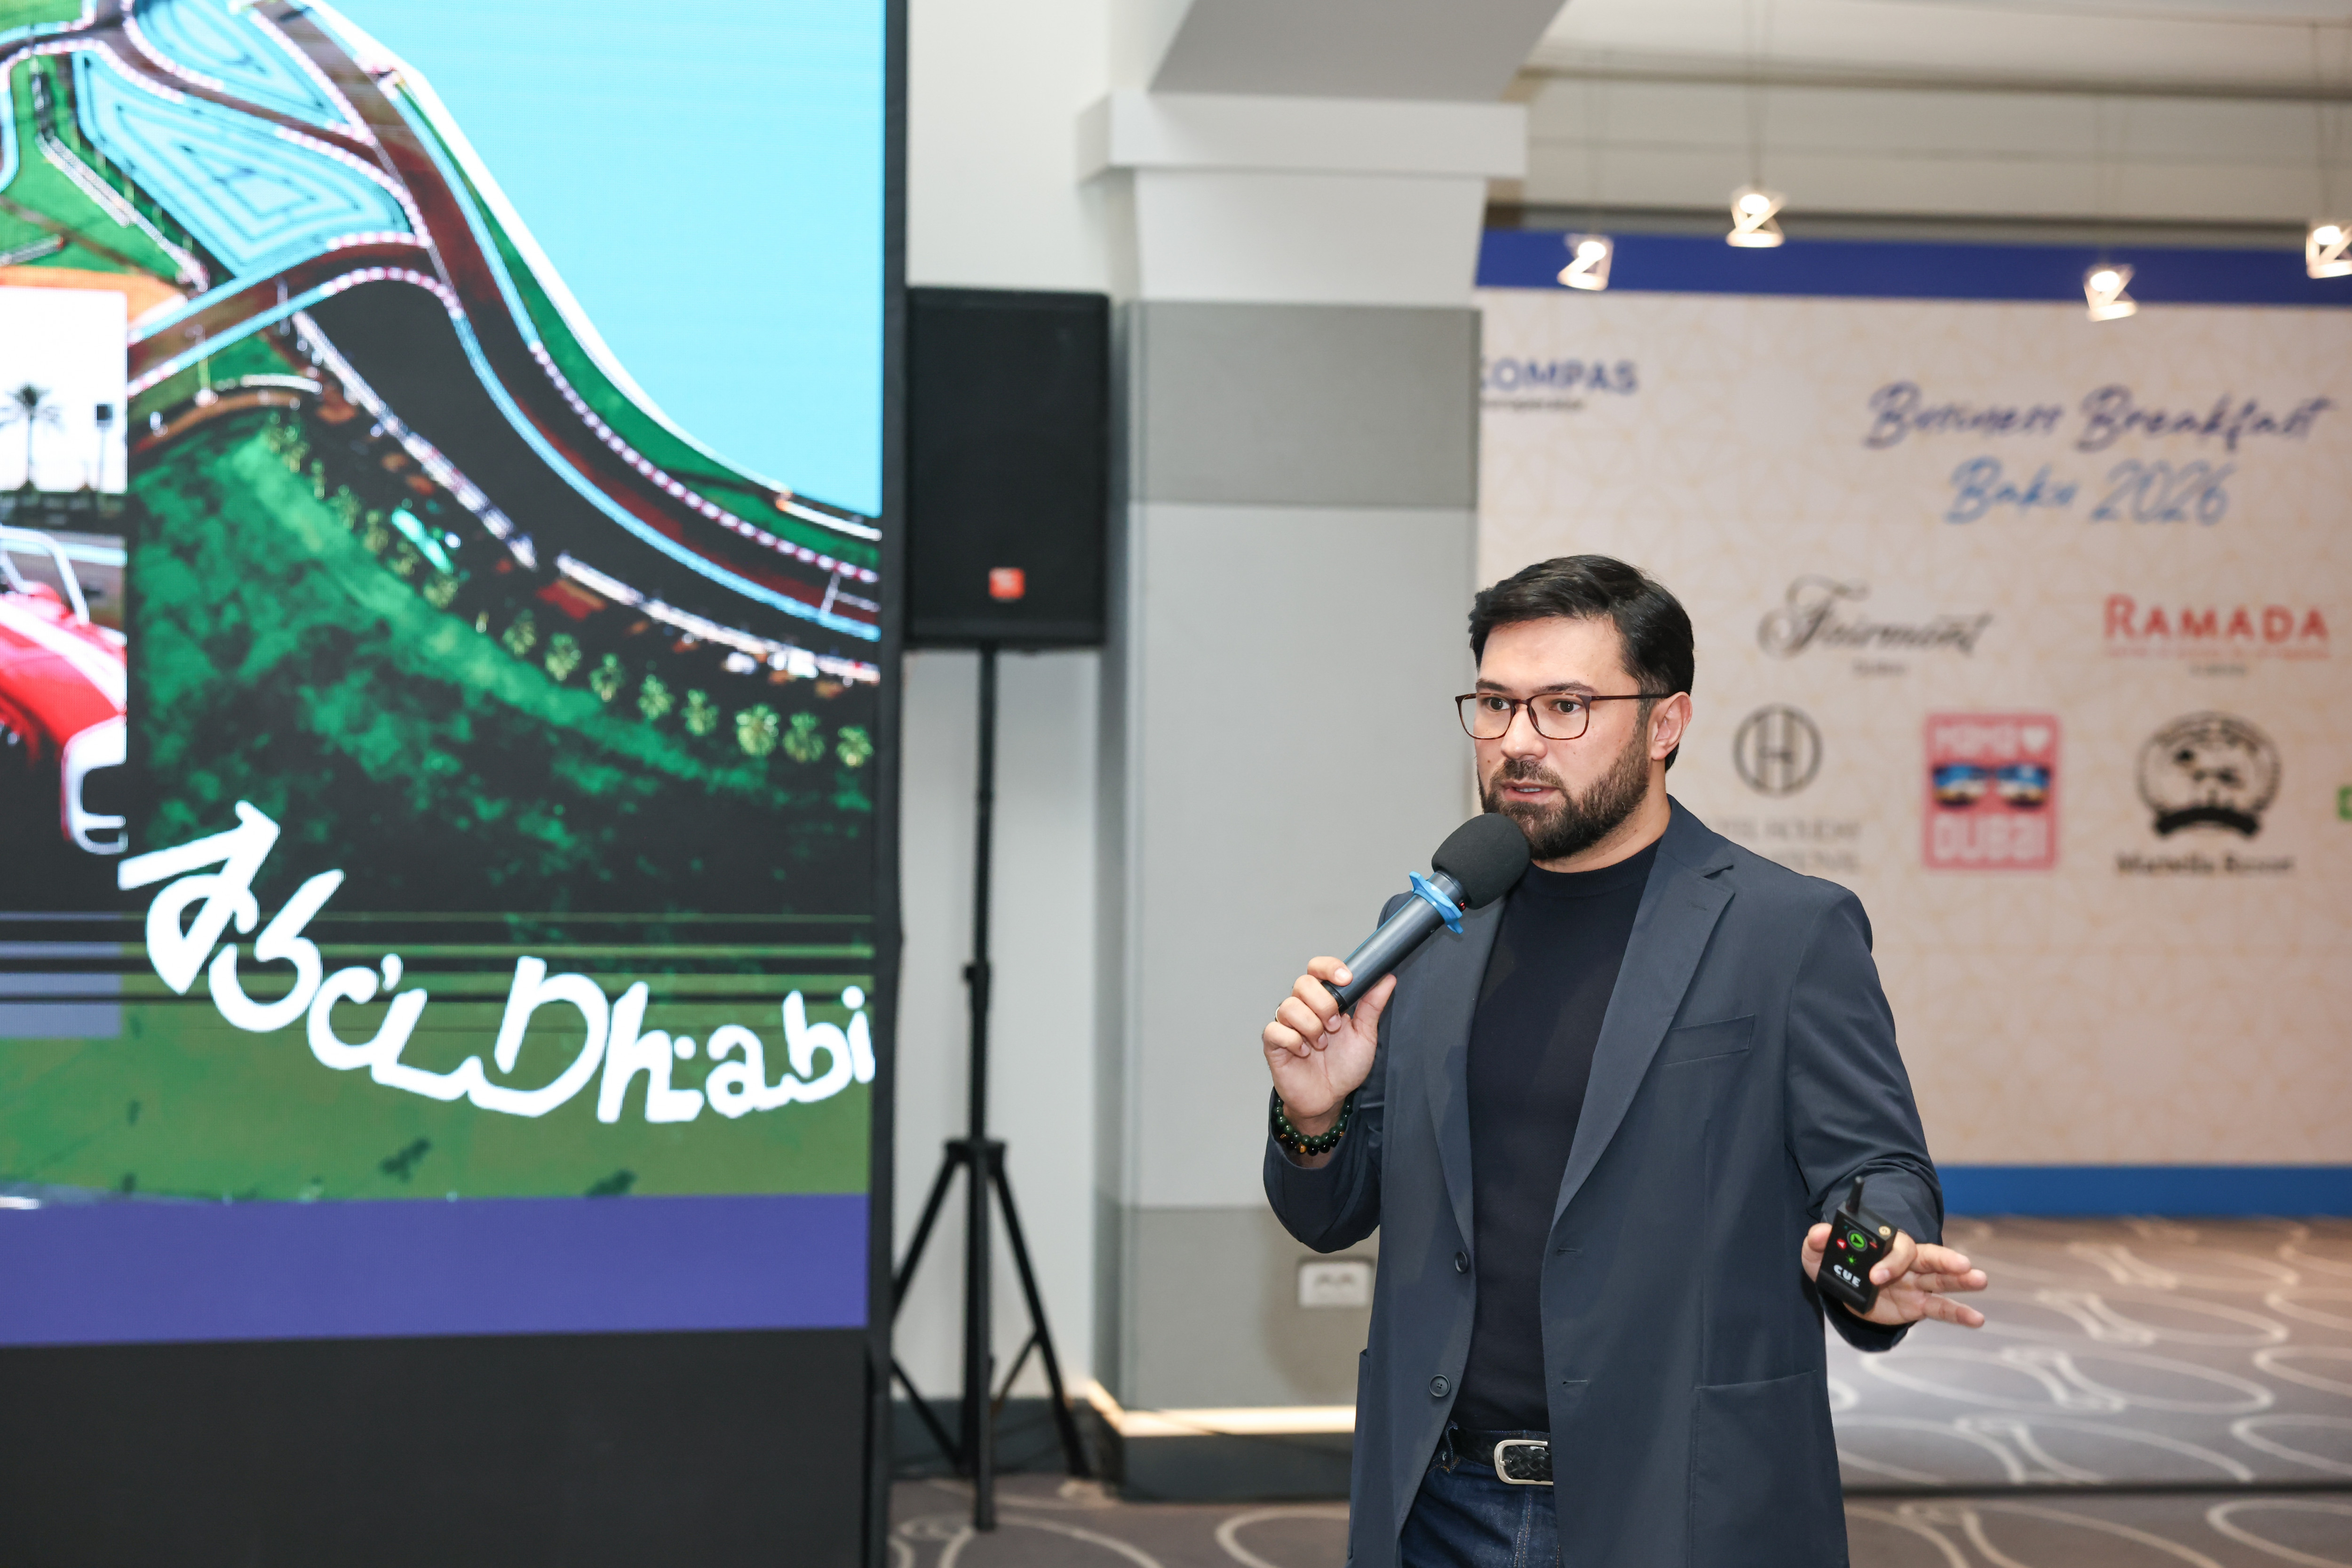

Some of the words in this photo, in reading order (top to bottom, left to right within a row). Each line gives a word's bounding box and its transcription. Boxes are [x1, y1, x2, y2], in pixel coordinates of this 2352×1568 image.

[1480, 356, 1640, 396] OMPAS
[1863, 381, 2065, 451] Business
[2074, 384, 2336, 453] Breakfast
[1944, 455, 2078, 526] Baku
[2090, 459, 2238, 526] 2026
[1756, 575, 1994, 658] Fairmont
[2104, 594, 2330, 642] RAMADA
[468, 956, 875, 1123] Dhabi
[1833, 1264, 1861, 1288] CUE
